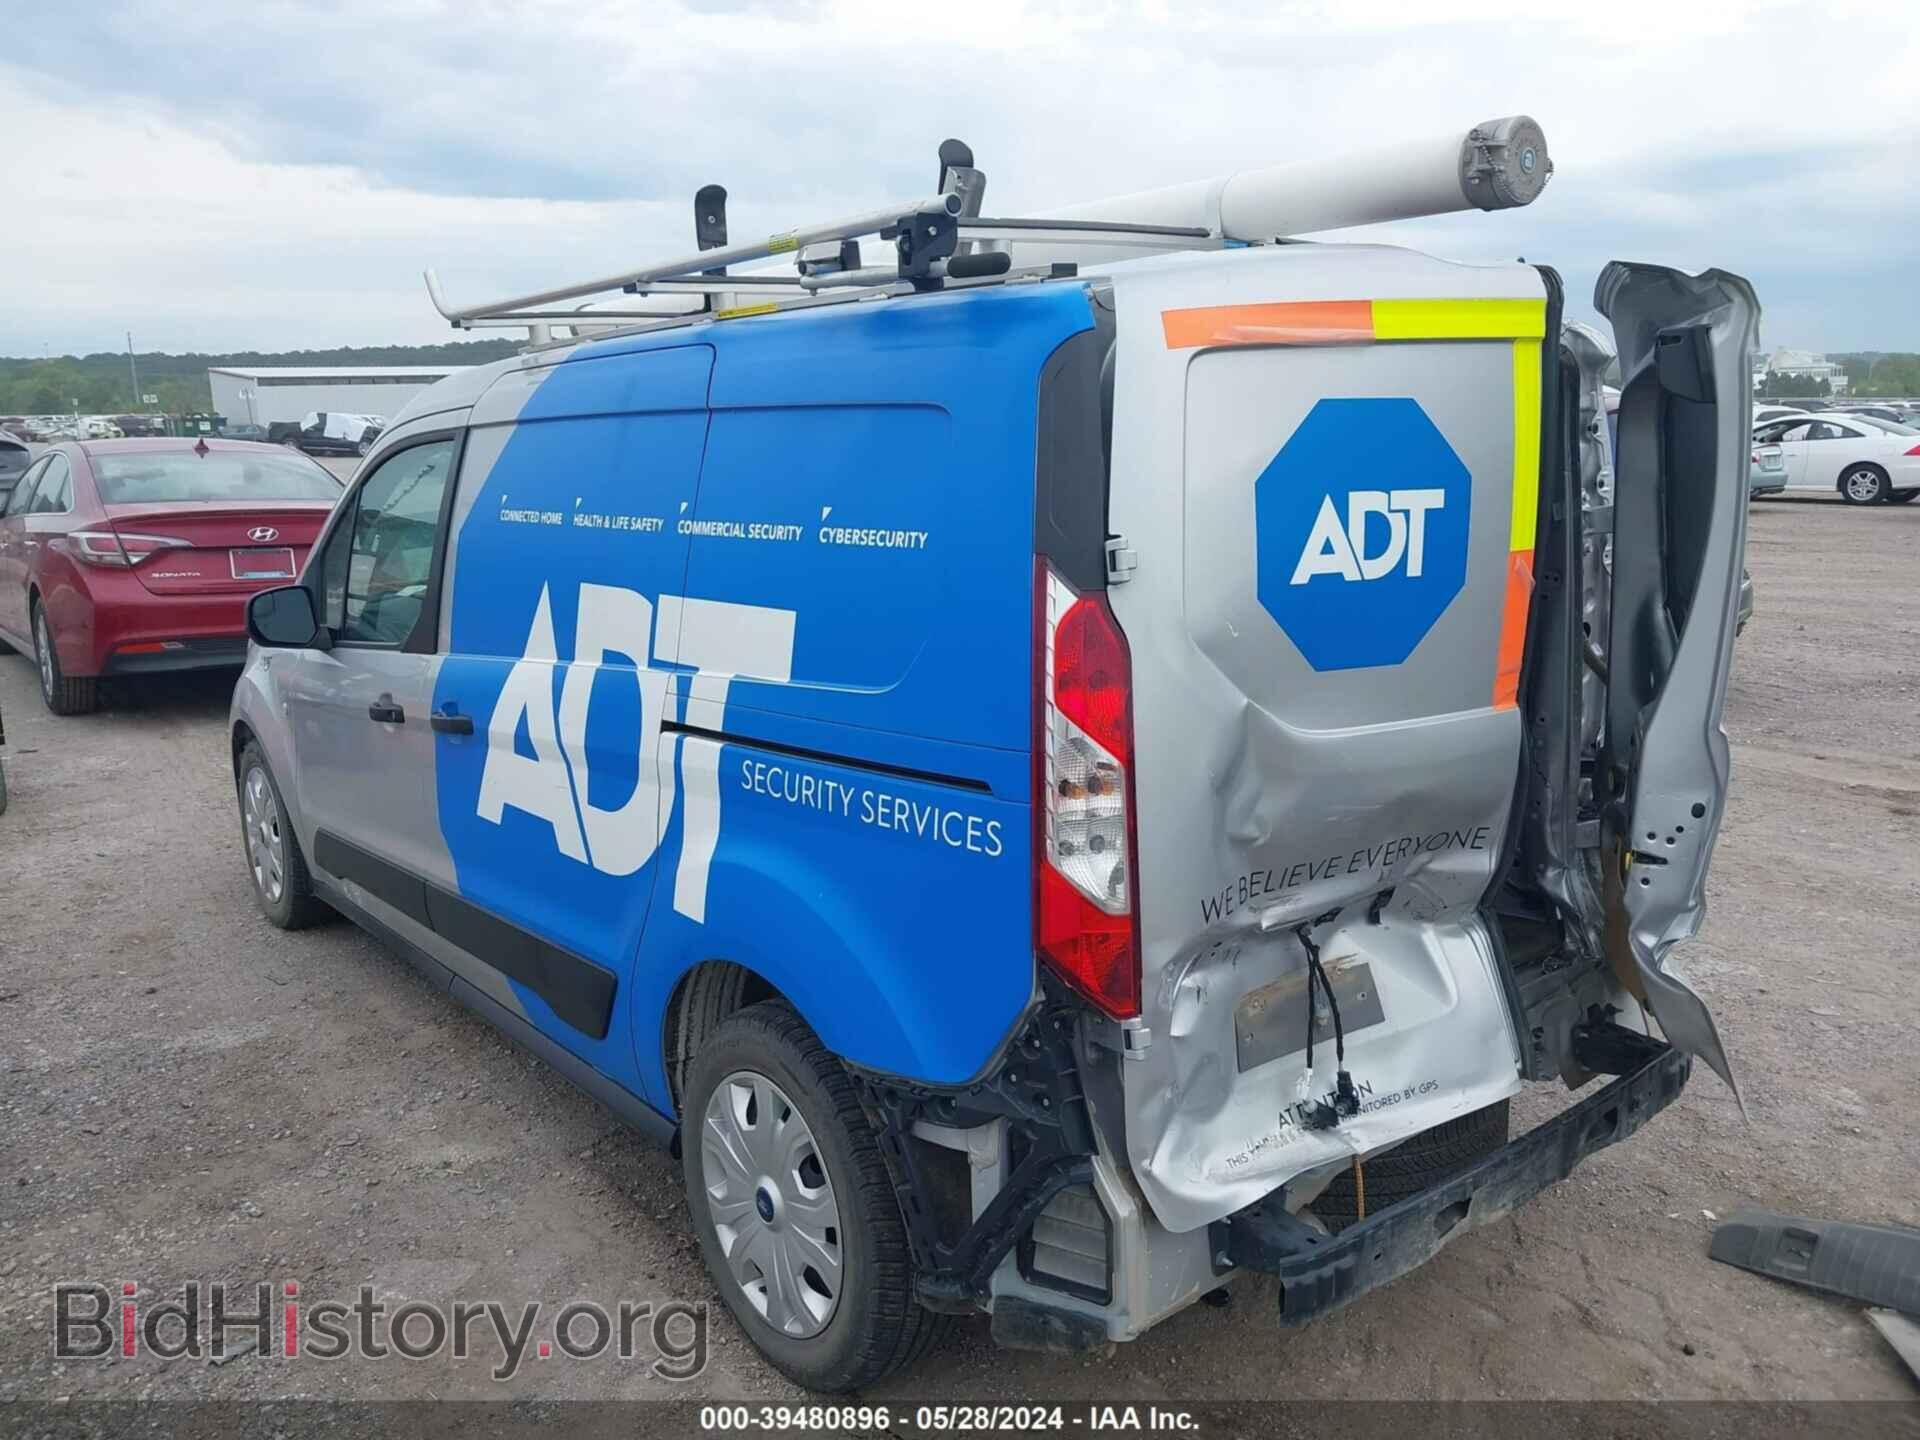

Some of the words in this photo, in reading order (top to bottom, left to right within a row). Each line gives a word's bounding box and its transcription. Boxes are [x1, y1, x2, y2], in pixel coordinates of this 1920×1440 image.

[500, 509, 539, 523] CONNECTED
[541, 512, 563, 525] HOME
[573, 513, 602, 528] HEALTH
[603, 516, 610, 528] &
[612, 516, 629, 530] LIFE
[631, 517, 664, 532] SAFETY
[677, 519, 745, 538] COMMERCIAL
[748, 523, 804, 541] SECURITY
[819, 526, 929, 549] CYBERSECURITY
[1289, 488, 1445, 585] ADT
[476, 579, 797, 924] ADT
[741, 759, 855, 817] SECURITY
[861, 790, 1003, 857] SERVICES
[1200, 885, 1234, 925] WE
[1238, 855, 1343, 905] BELIEVE
[1346, 826, 1490, 873] EVERYONE
[1225, 1152, 1249, 1169] THIS
[1404, 1085, 1416, 1100] BY
[1418, 1079, 1440, 1094] GPS
[1278, 1079, 1374, 1130] ATTNTON
